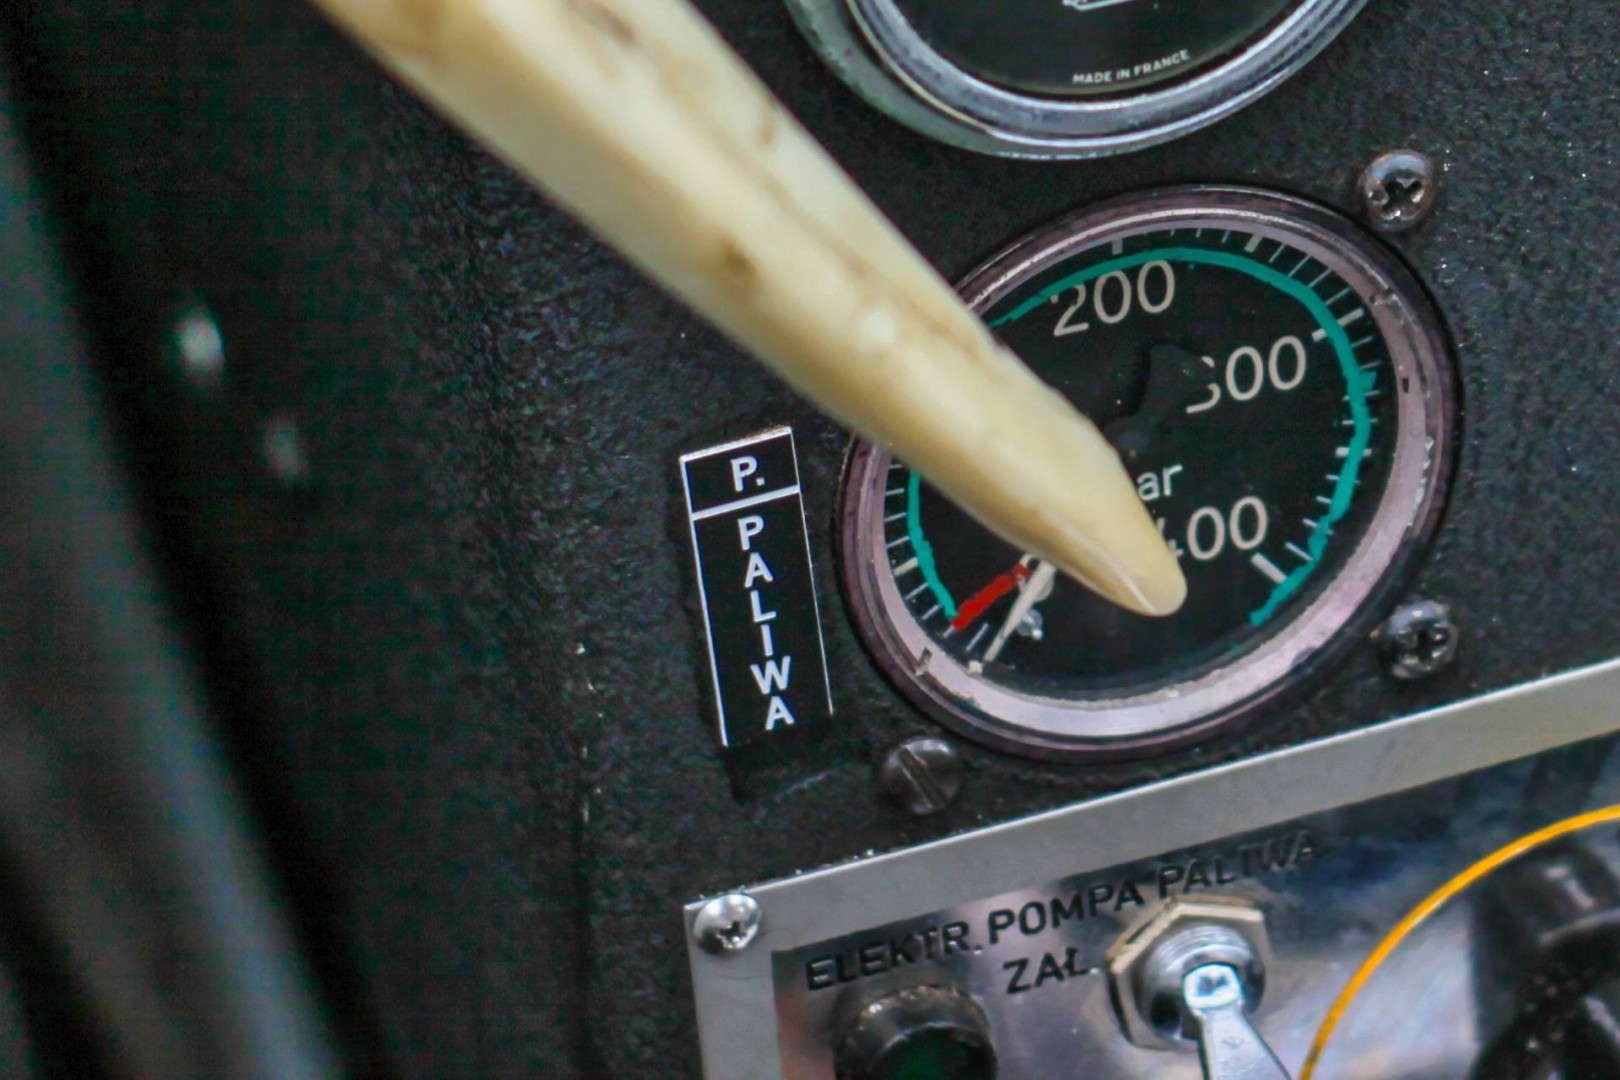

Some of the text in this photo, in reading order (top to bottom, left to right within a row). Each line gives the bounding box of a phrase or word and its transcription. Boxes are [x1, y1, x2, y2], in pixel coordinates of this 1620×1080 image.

[1071, 48, 1191, 85] MADE IN FRANCE
[1050, 258, 1176, 337] 200
[730, 455, 767, 493] P.
[1136, 464, 1183, 502] ar
[736, 514, 796, 732] PALIWA
[803, 828, 1316, 992] ELEKTR. POMPA PALIWA
